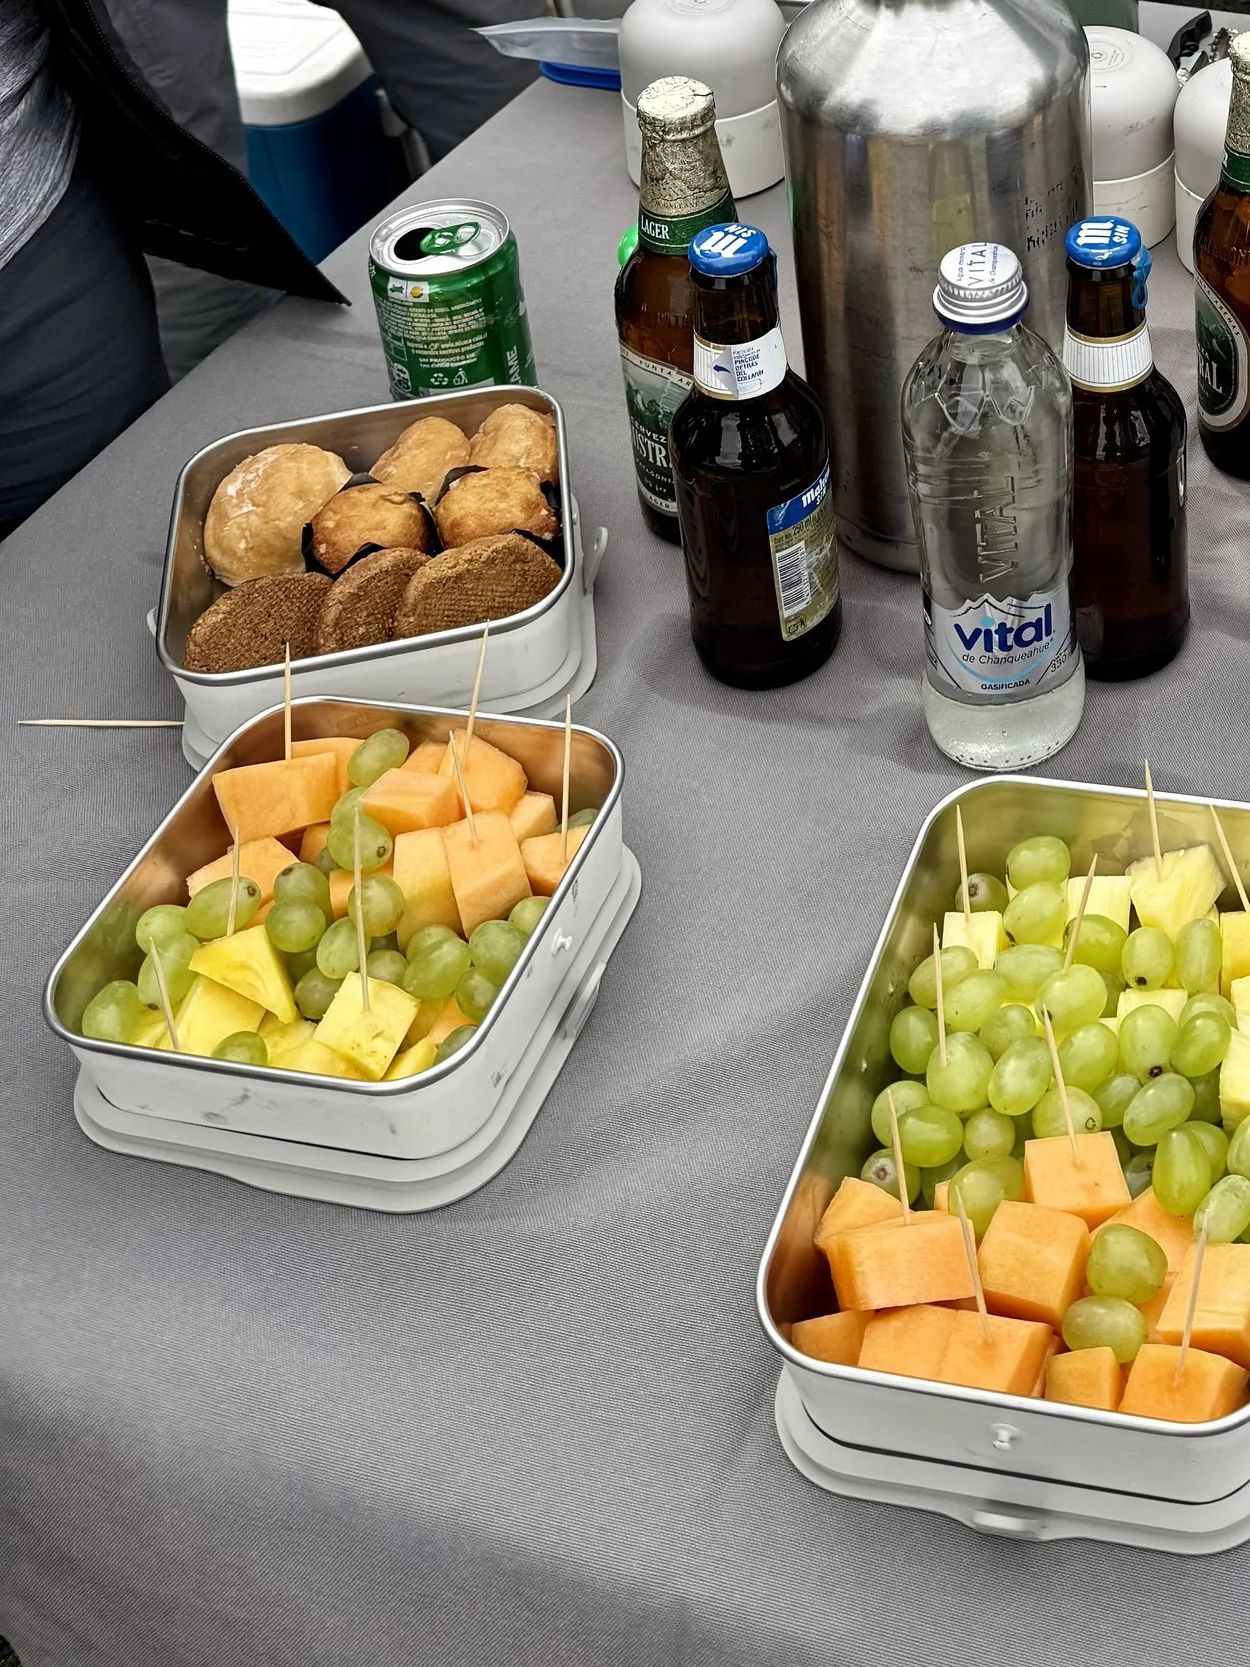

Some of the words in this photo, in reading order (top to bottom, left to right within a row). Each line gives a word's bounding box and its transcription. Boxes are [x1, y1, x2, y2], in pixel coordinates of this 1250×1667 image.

[640, 215, 670, 240] LAGER
[723, 223, 758, 238] SIN
[1113, 224, 1130, 245] SIN
[966, 242, 988, 287] VITAL
[1213, 299, 1241, 338] ARENAS
[639, 358, 673, 376] PUNTA
[974, 476, 1018, 583] VITAL
[954, 603, 1052, 654] vital
[962, 652, 975, 663] de
[978, 641, 1050, 666] Chanqueahue
[1050, 656, 1067, 673] 330
[981, 678, 1031, 690] GASIFICADA
